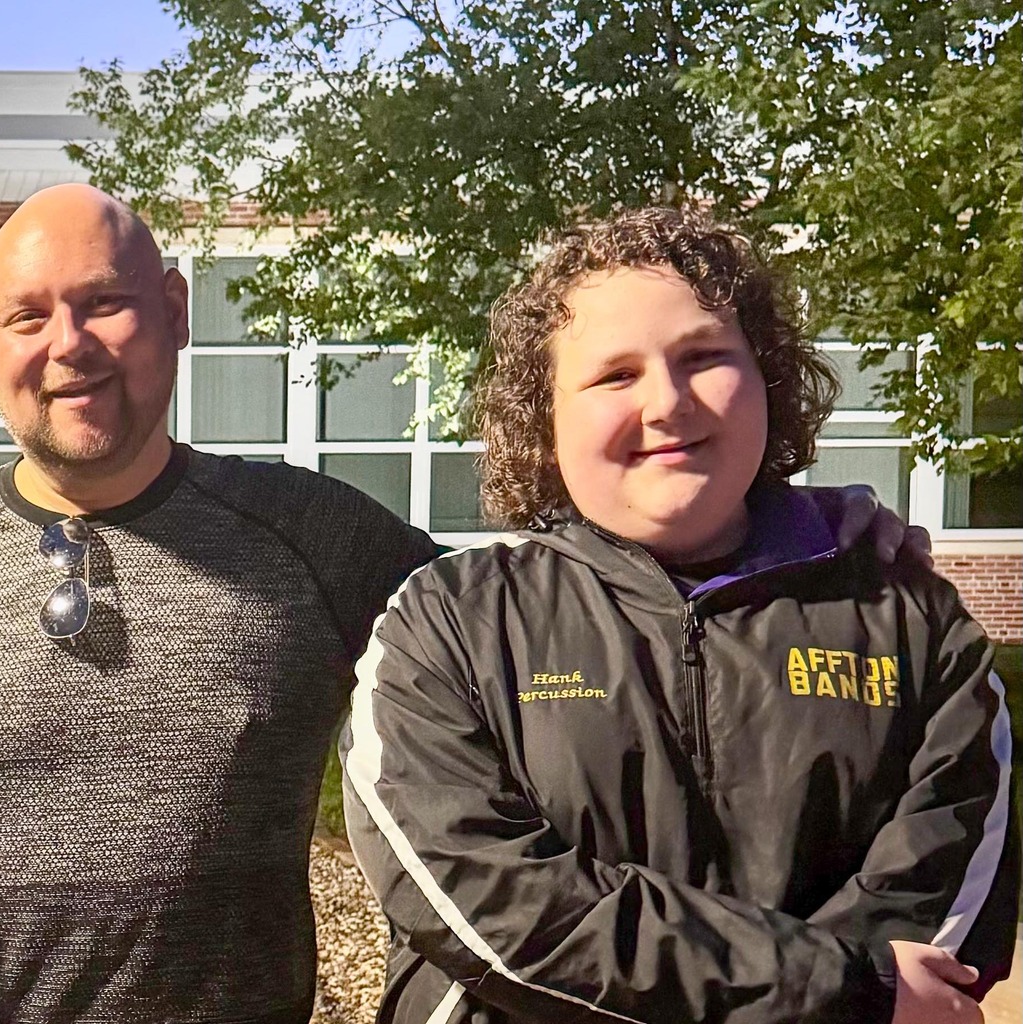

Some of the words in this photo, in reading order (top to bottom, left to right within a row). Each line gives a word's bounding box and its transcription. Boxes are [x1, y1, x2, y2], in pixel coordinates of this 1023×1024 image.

[531, 670, 585, 685] Hank
[787, 647, 900, 682] AFFTON
[788, 671, 901, 708] BANDS
